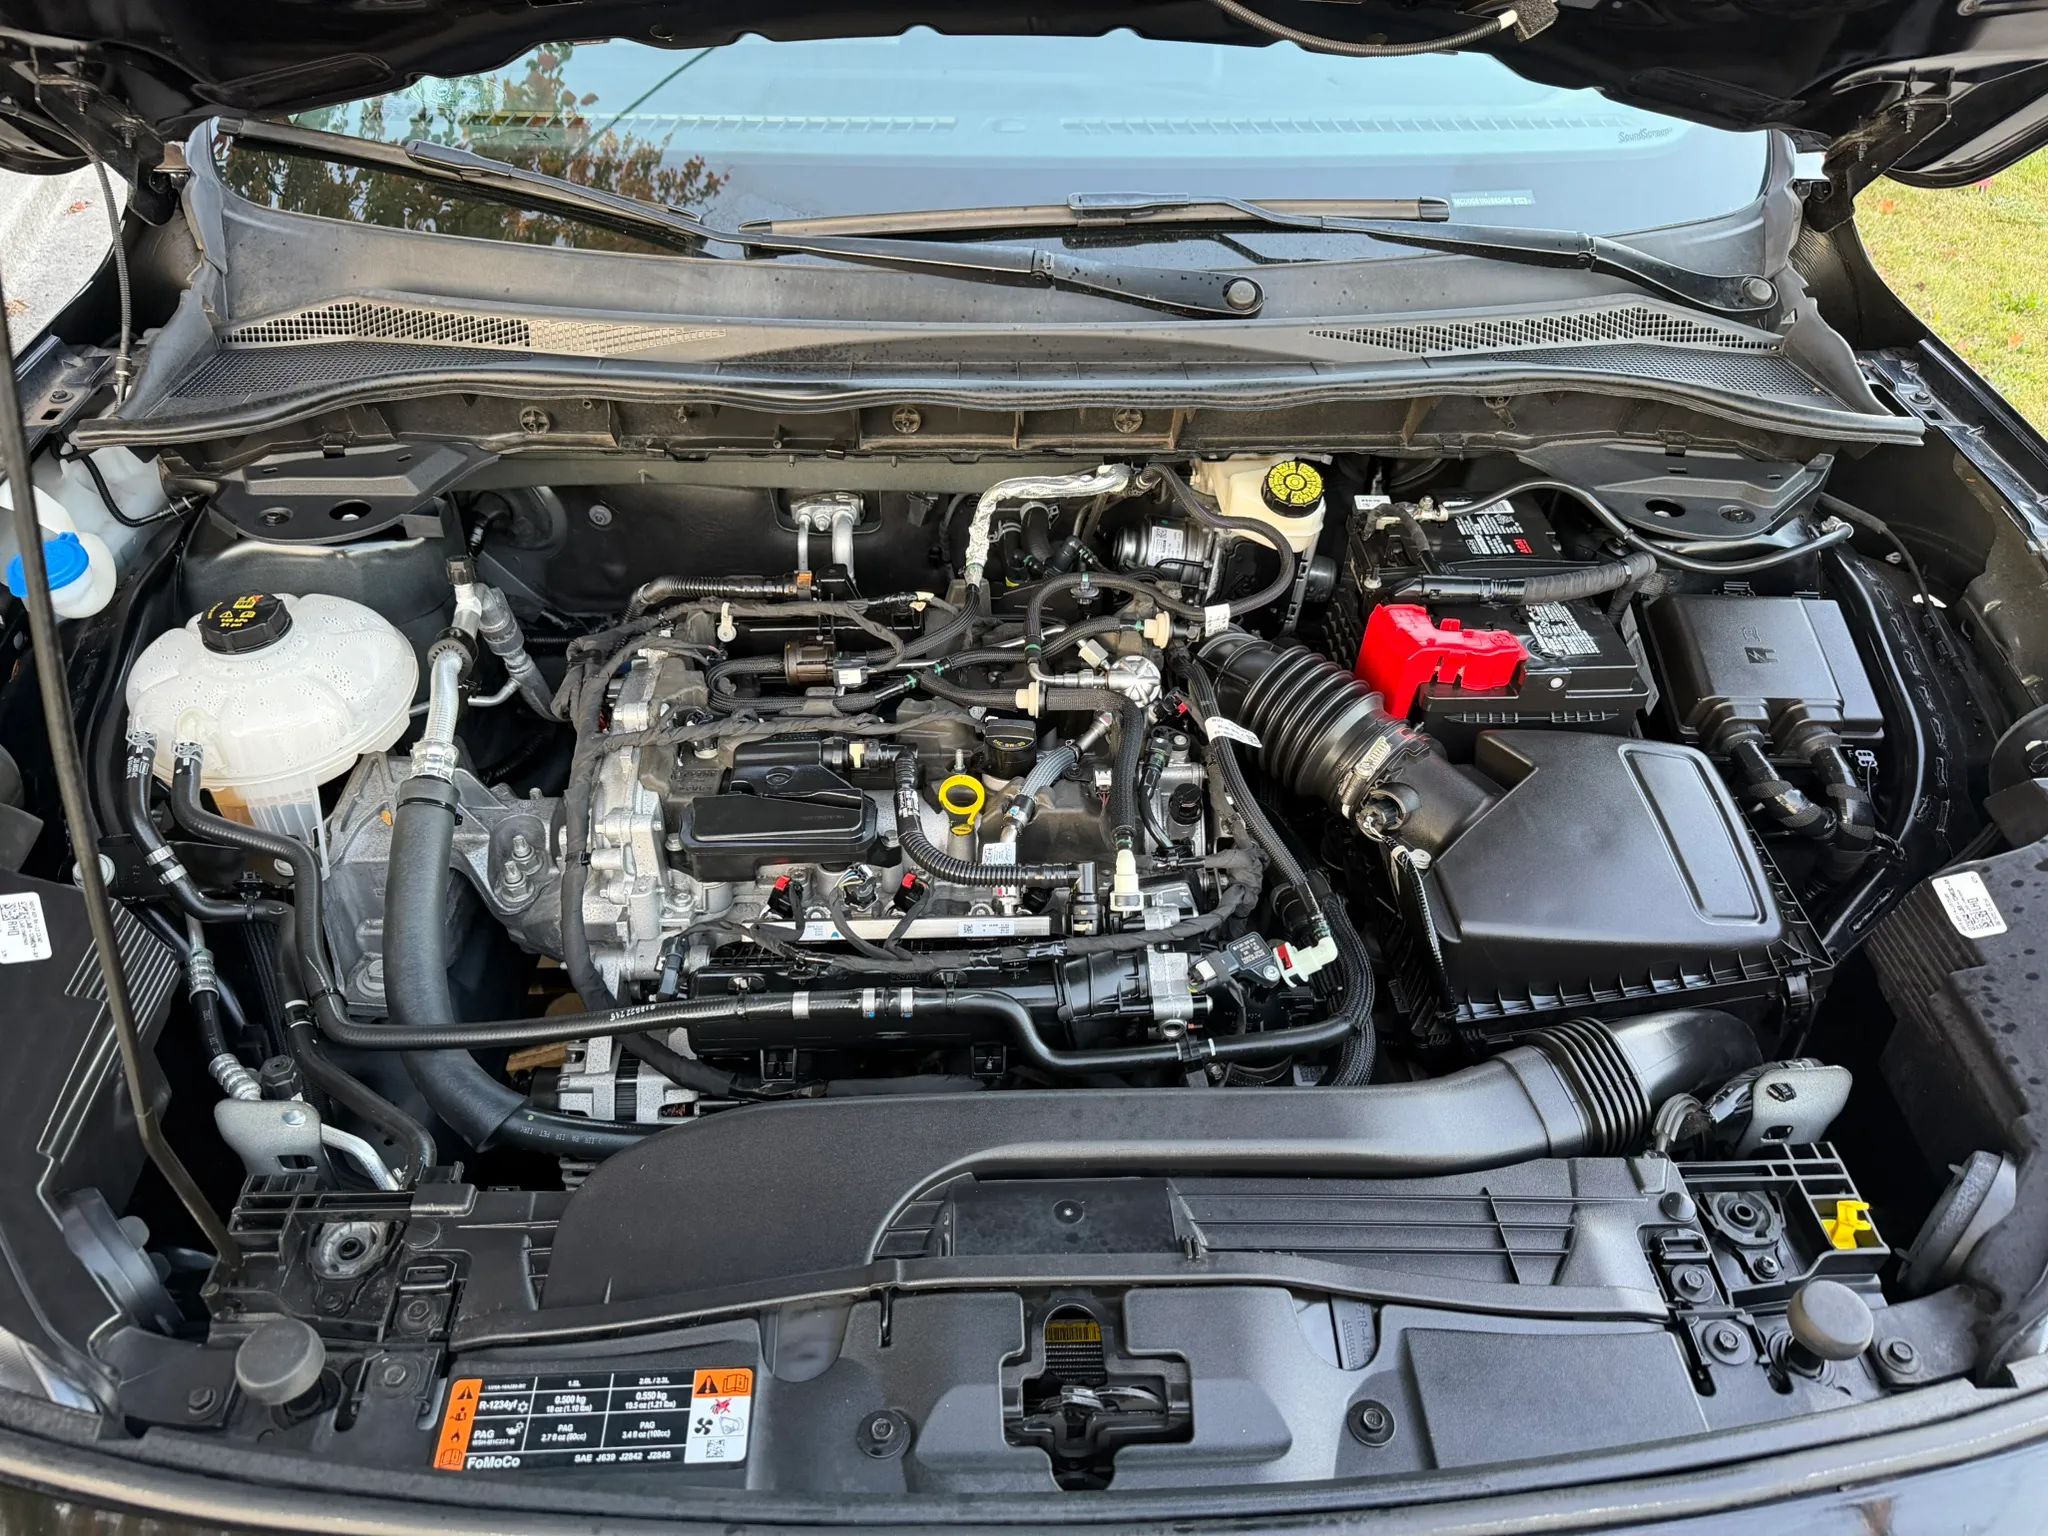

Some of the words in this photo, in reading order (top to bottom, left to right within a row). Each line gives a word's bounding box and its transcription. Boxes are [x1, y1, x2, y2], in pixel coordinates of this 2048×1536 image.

[554, 1396, 576, 1405] 0.500
[577, 1395, 586, 1406] kg
[636, 1392, 656, 1401] 0.550
[657, 1391, 667, 1401] kg
[479, 1400, 518, 1411] R-1234yf
[557, 1424, 574, 1432] PAG
[639, 1421, 655, 1429] PAG
[474, 1430, 495, 1439] PAG
[574, 1454, 593, 1462] SAE
[596, 1453, 616, 1462] J639
[467, 1456, 520, 1469] FoMoCo
